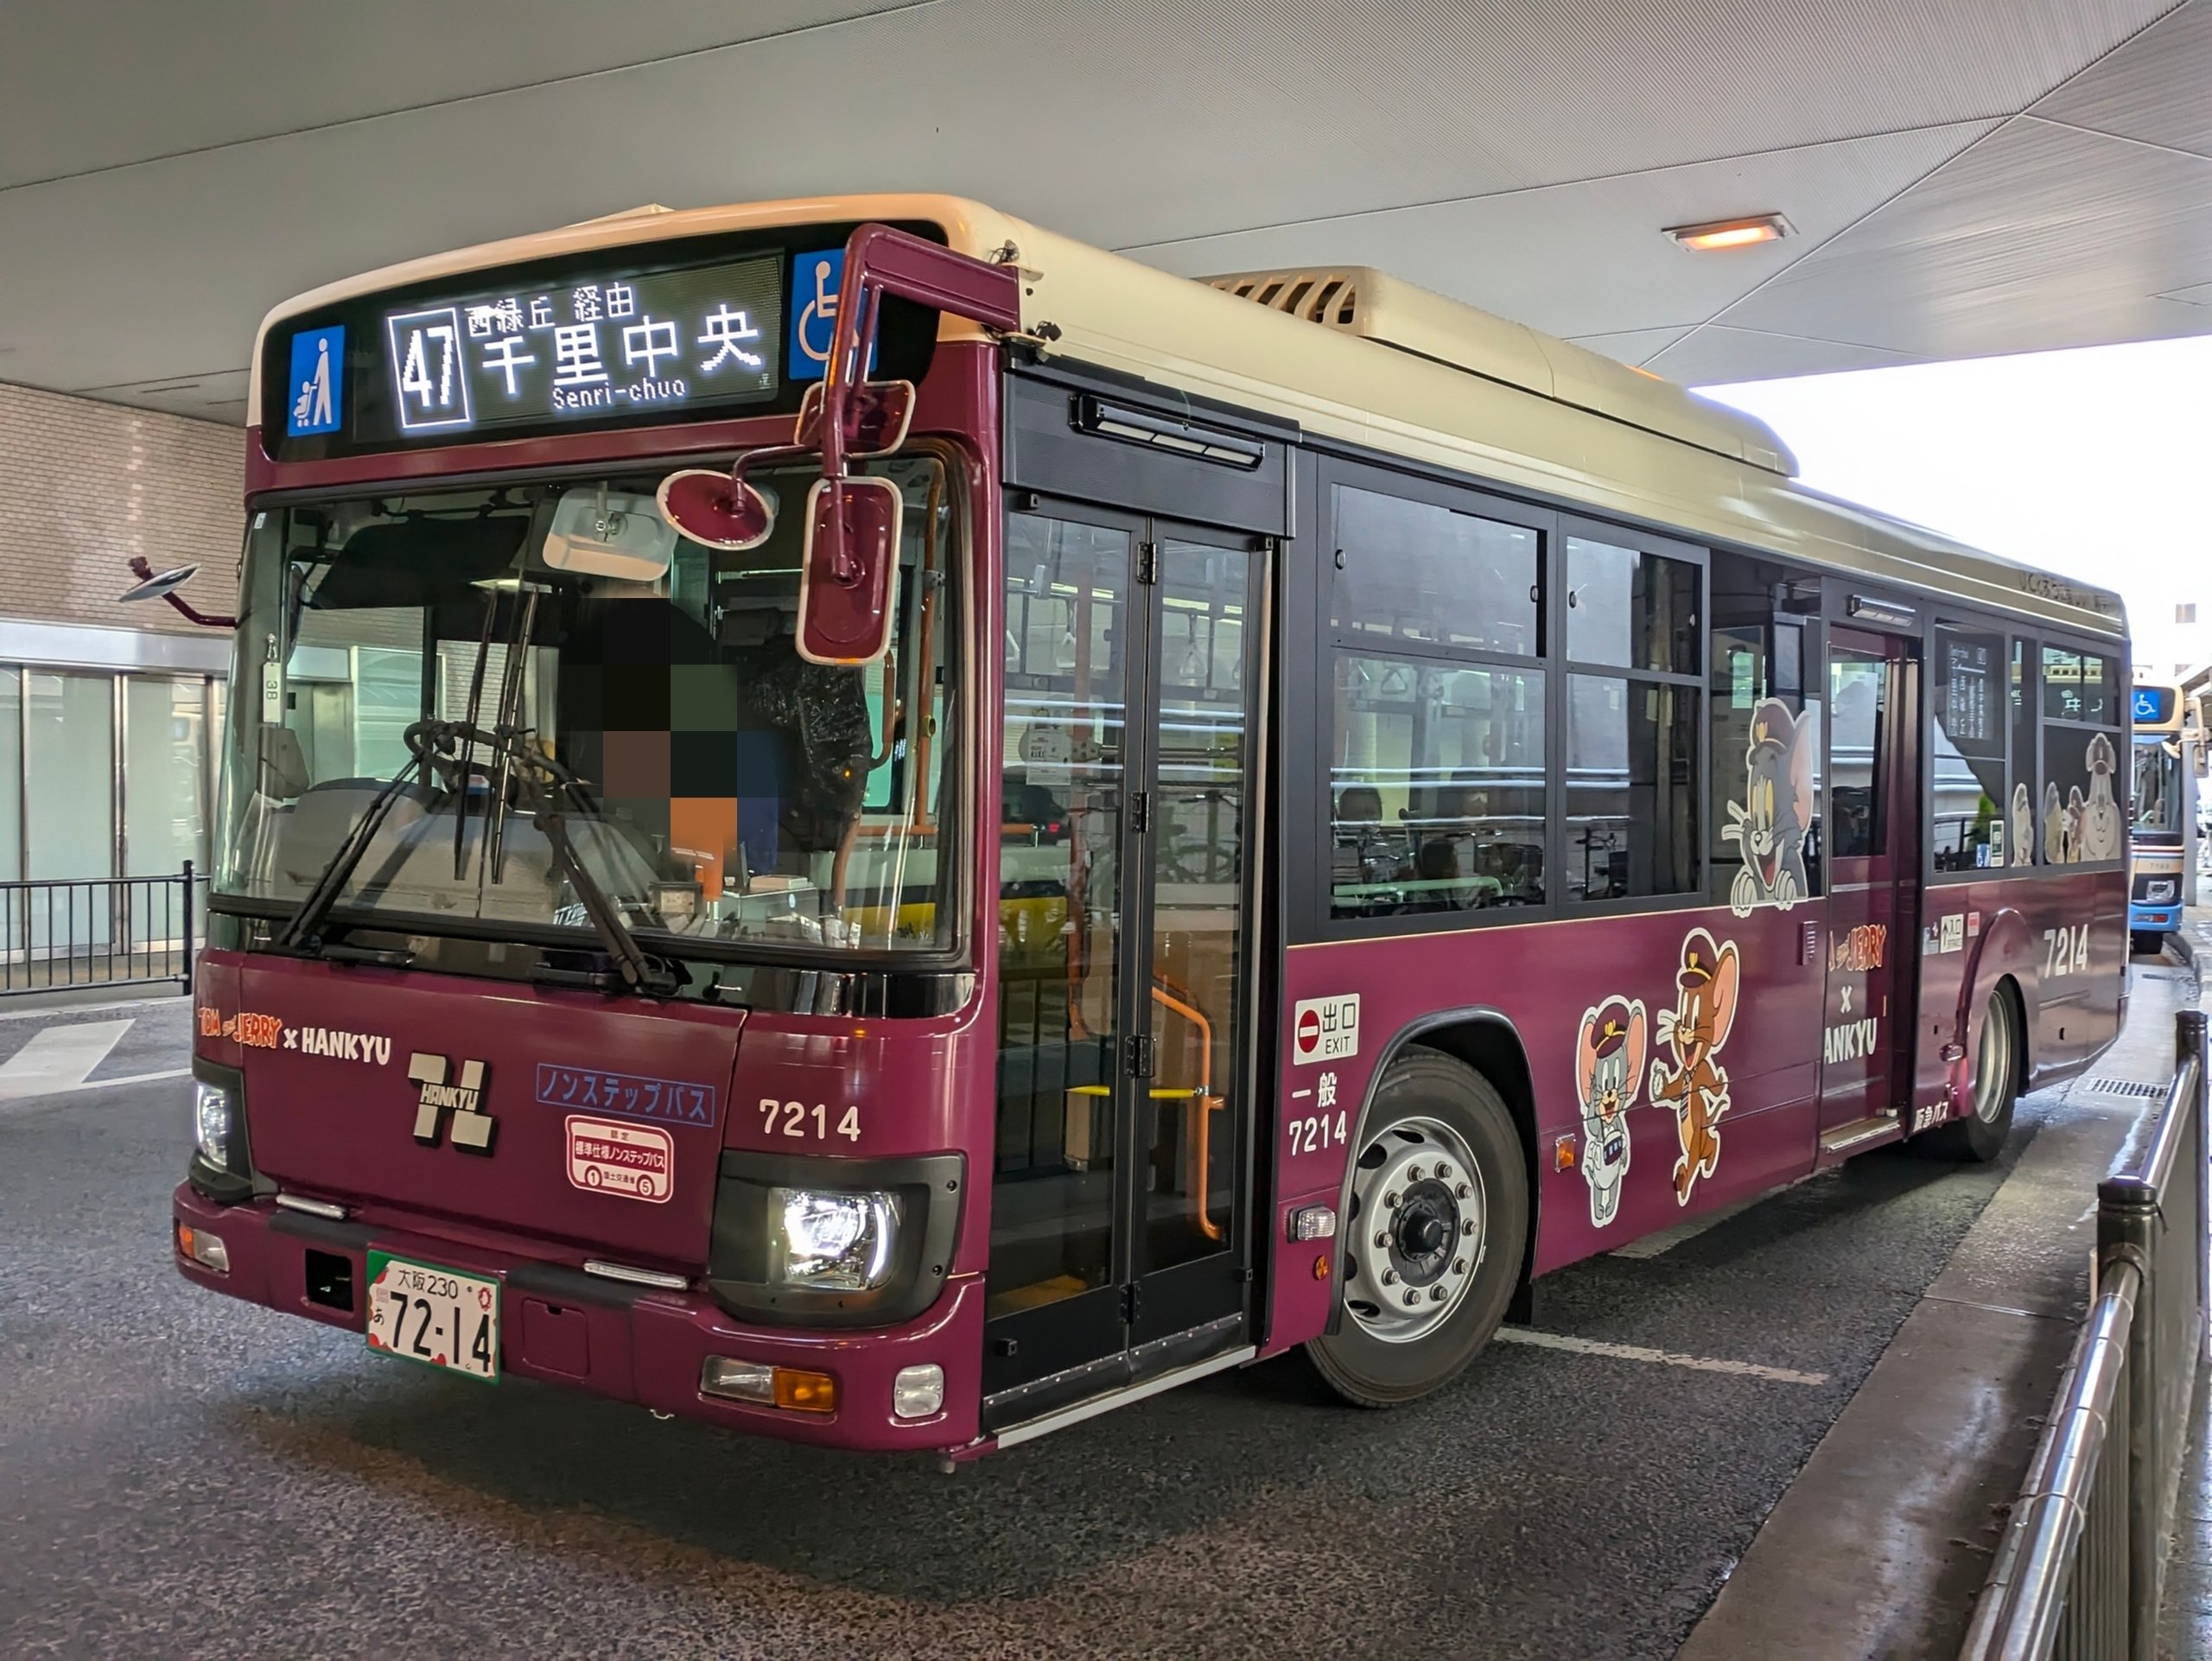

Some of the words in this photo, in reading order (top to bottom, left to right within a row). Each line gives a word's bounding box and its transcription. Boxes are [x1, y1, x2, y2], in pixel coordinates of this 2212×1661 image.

[572, 282, 635, 322] 経由
[401, 326, 455, 409] 47
[481, 303, 762, 395] 千里中央
[551, 377, 686, 410] Senri-chuo
[2044, 924, 2088, 978] 7214
[198, 1007, 221, 1036] TOM
[232, 1012, 283, 1048] JERRY
[302, 1027, 391, 1066] HANKYU
[1322, 1002, 1356, 1033] 出口
[1824, 1017, 1878, 1064] ANKYU
[1325, 1036, 1351, 1054] EXIT
[420, 1083, 480, 1111] HANKYU
[542, 1070, 707, 1121] ノンステップバス
[1292, 1072, 1337, 1108] 一般
[759, 1099, 861, 1142] 7214
[1289, 1110, 1347, 1156] 7214
[391, 1291, 491, 1372] 72-14
